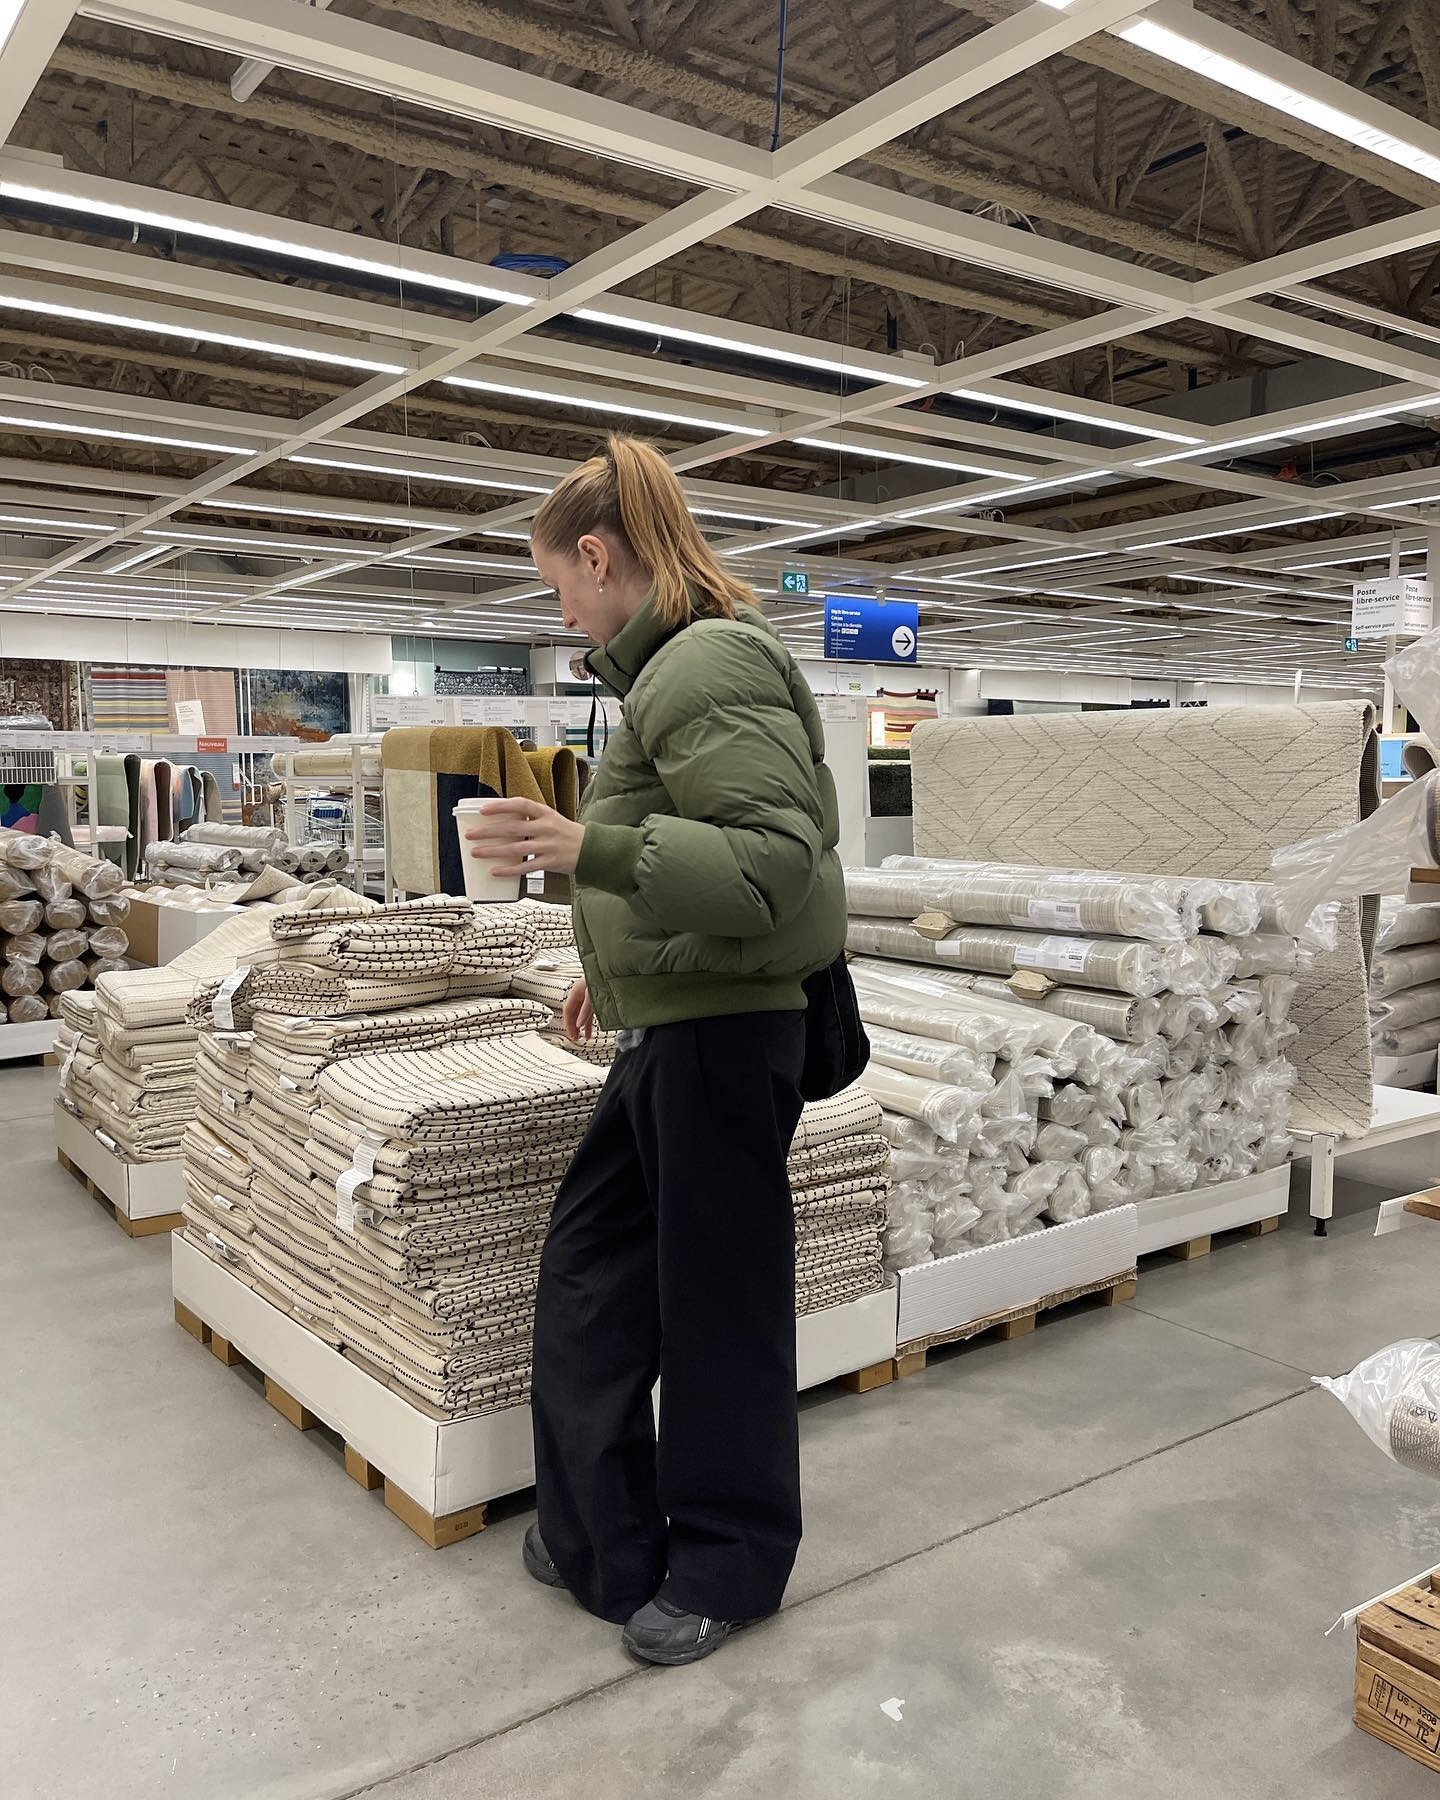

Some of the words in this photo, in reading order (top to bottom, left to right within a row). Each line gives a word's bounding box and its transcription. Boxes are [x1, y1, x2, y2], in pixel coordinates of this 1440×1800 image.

[1357, 594, 1400, 604] libre-service
[1405, 593, 1432, 603] libre-service
[1397, 1692, 1410, 1706] US
[1416, 1707, 1437, 1726] 3208
[1393, 1708, 1412, 1729] HT
